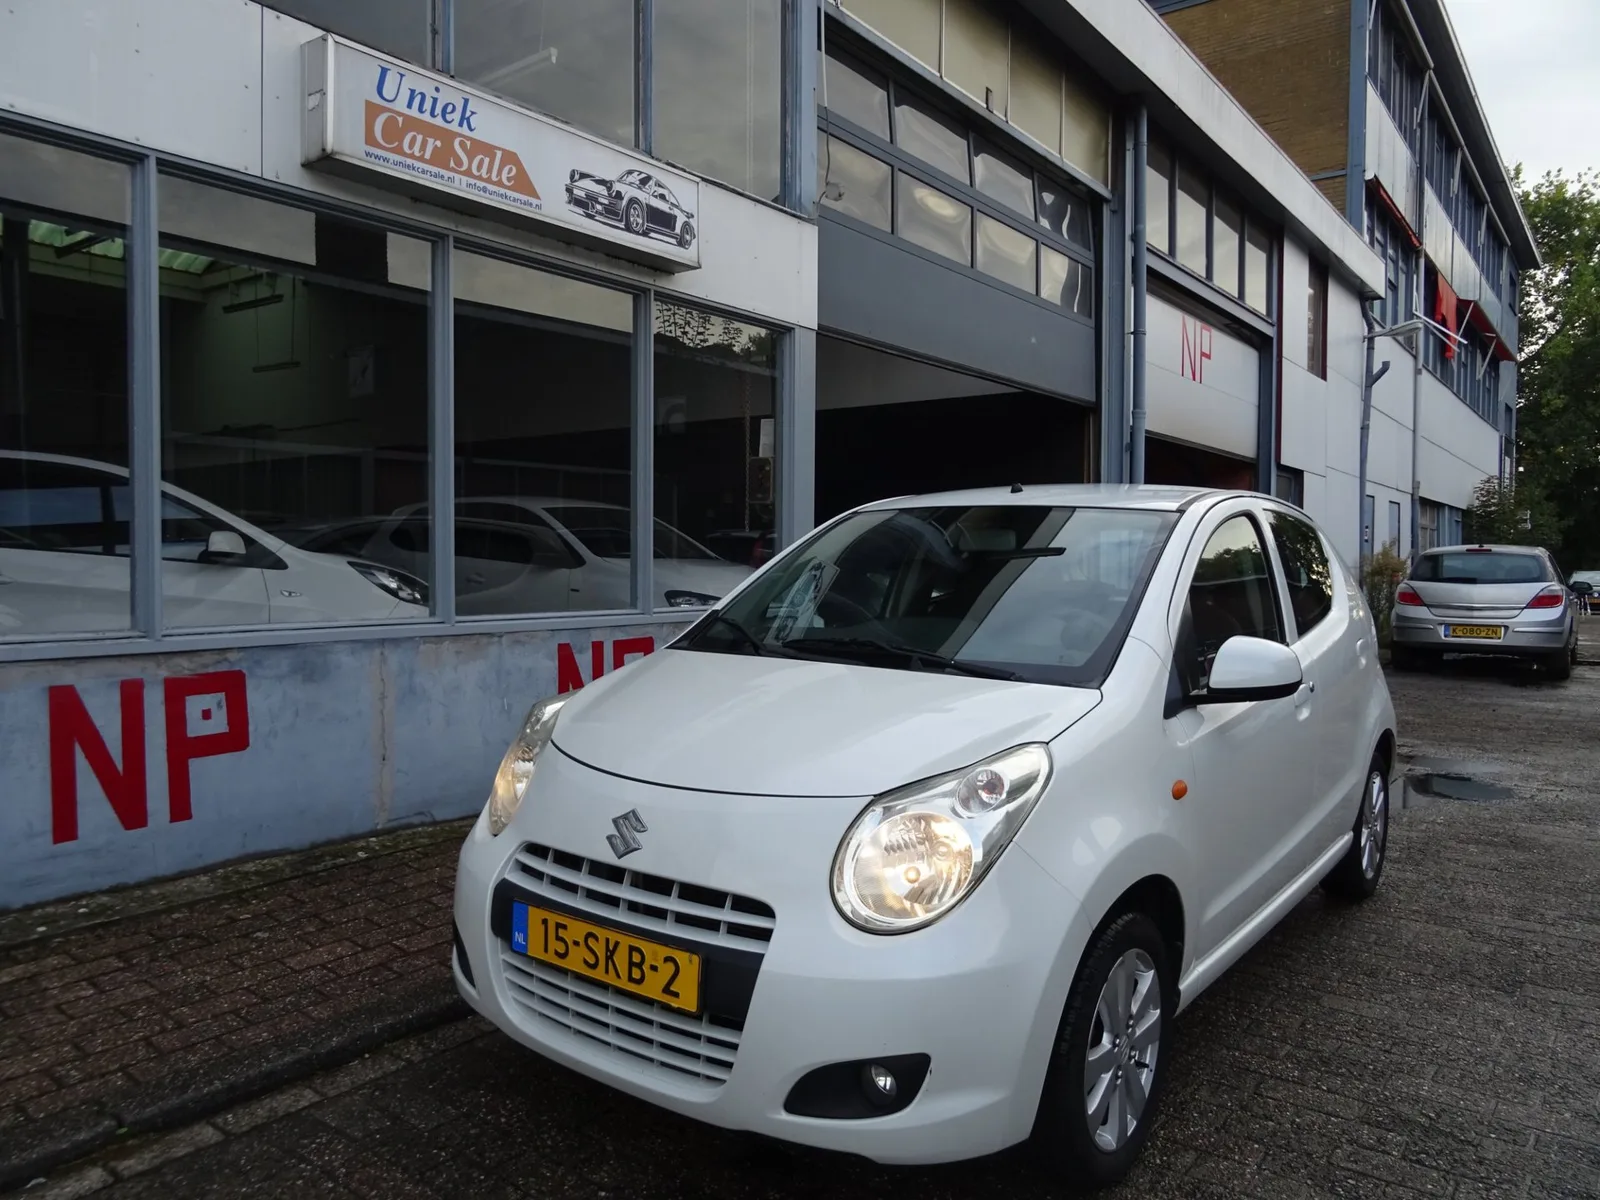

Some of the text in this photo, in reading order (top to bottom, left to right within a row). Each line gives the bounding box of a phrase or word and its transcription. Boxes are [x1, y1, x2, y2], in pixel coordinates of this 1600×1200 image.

[375, 64, 478, 132] Uniek
[364, 150, 455, 184] www.uniekcarsale.nl
[465, 180, 543, 211] info@uniekcarsale.nl
[373, 112, 517, 187] Car Sale
[1181, 312, 1212, 384] NP
[48, 669, 250, 845] NP
[514, 917, 681, 999] NL 15-SKB-2
